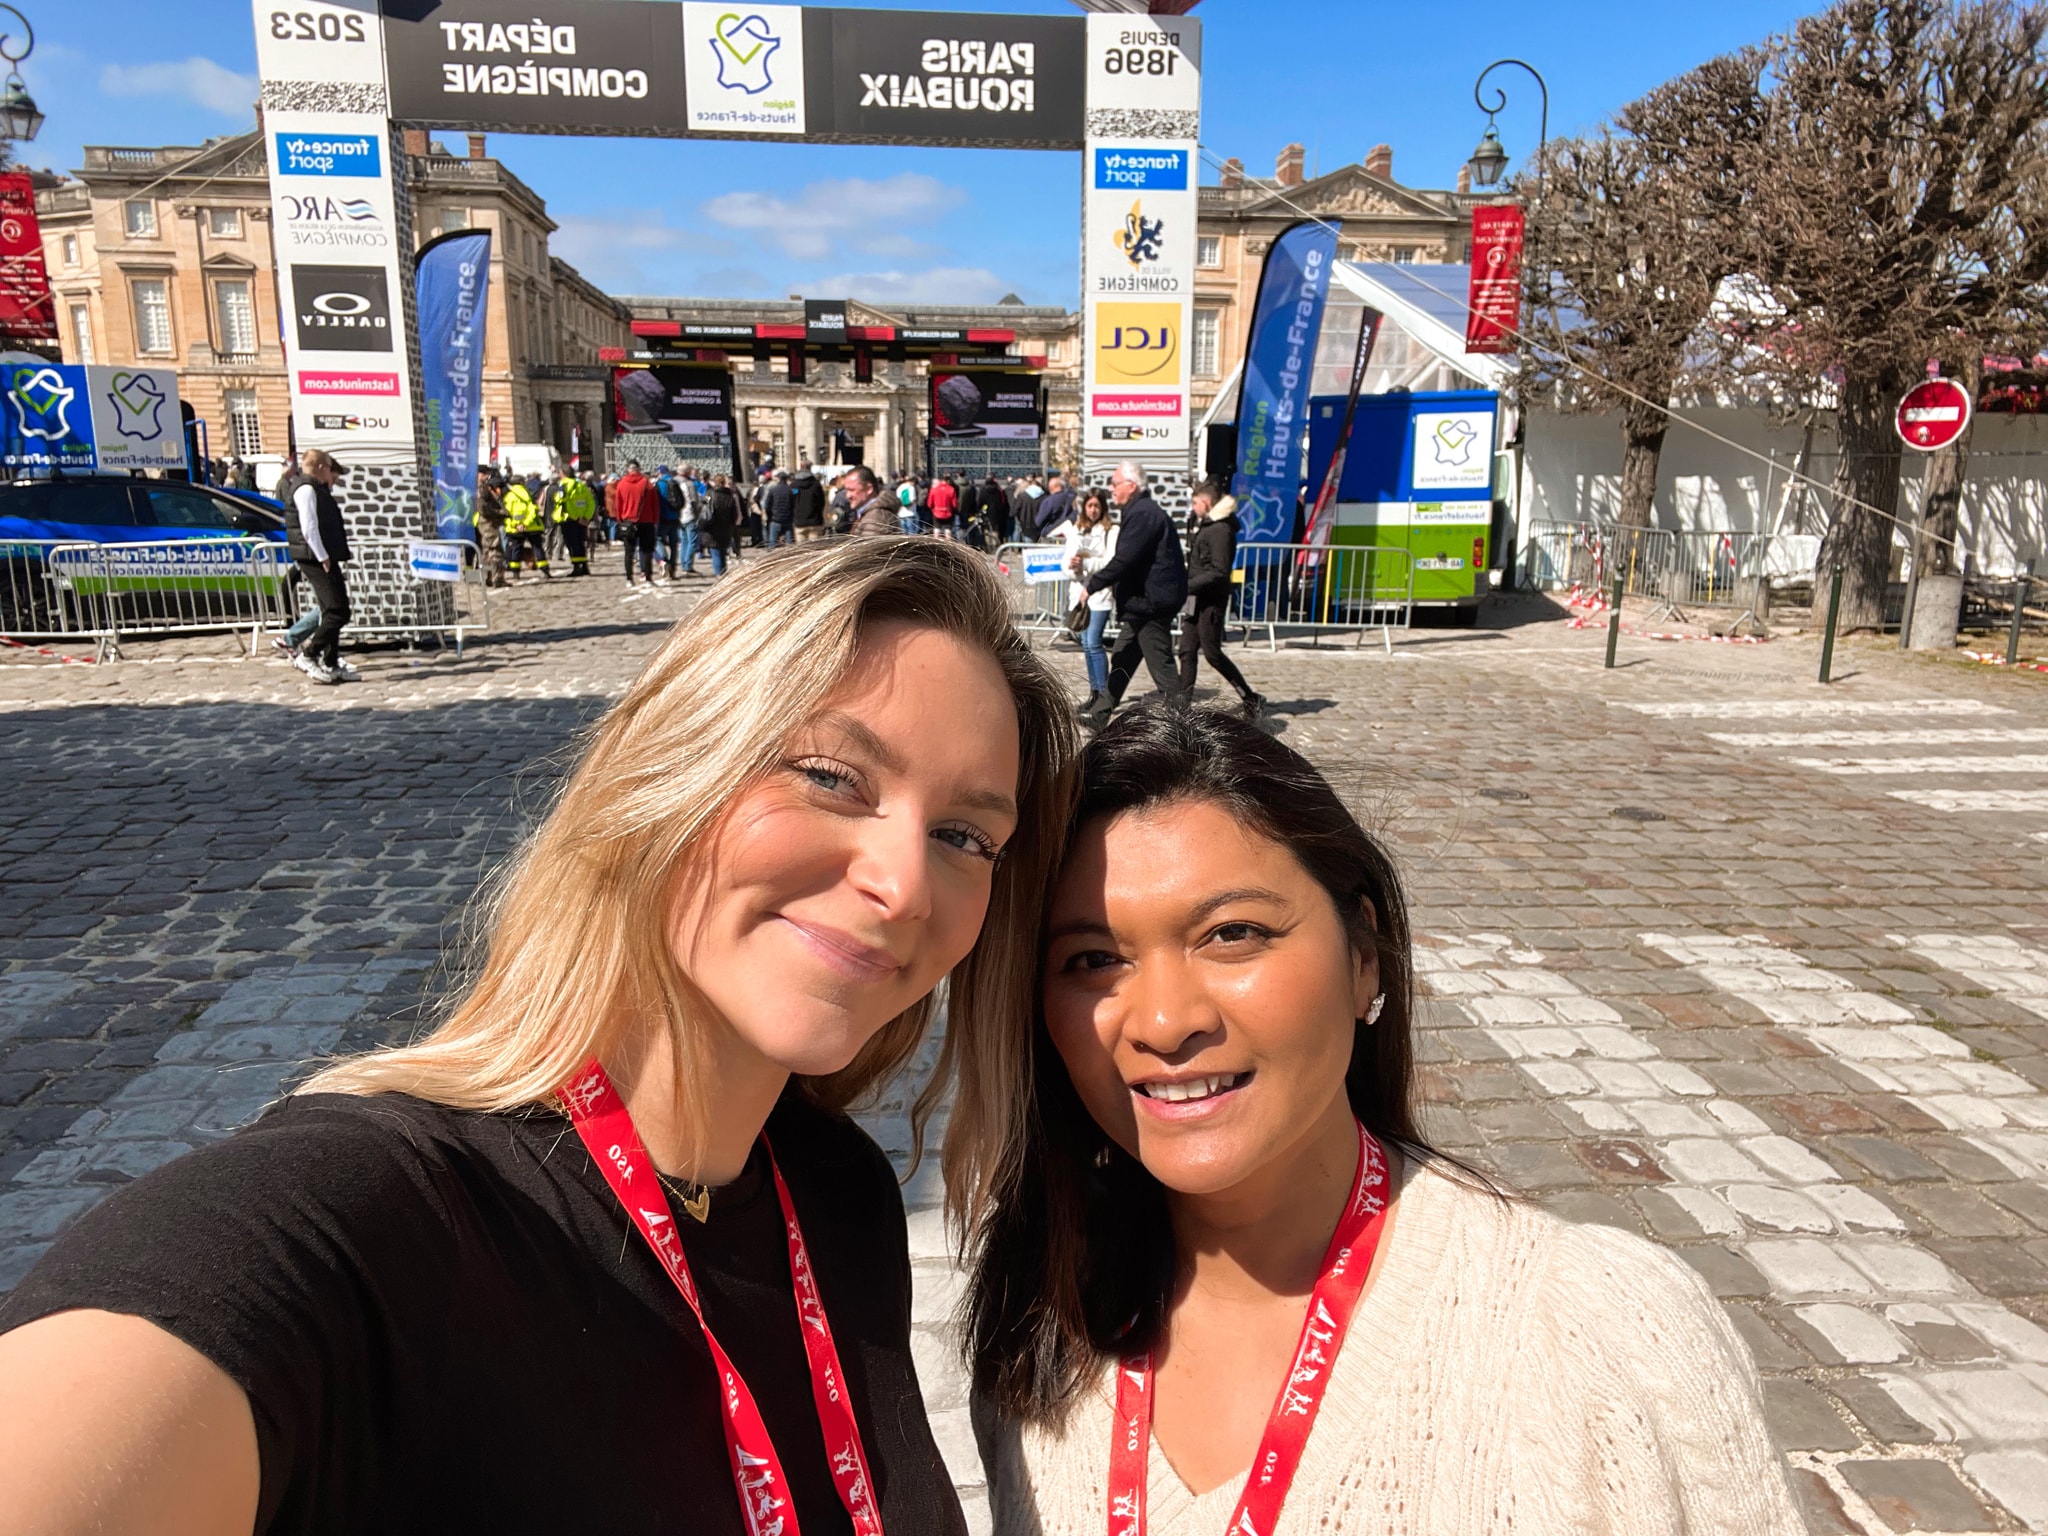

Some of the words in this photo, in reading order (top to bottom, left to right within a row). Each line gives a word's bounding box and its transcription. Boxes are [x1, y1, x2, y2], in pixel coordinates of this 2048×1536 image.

[445, 260, 477, 472] Hauts-de-France
[1243, 399, 1269, 478] Région
[1263, 249, 1323, 479] Hauts-de-France
